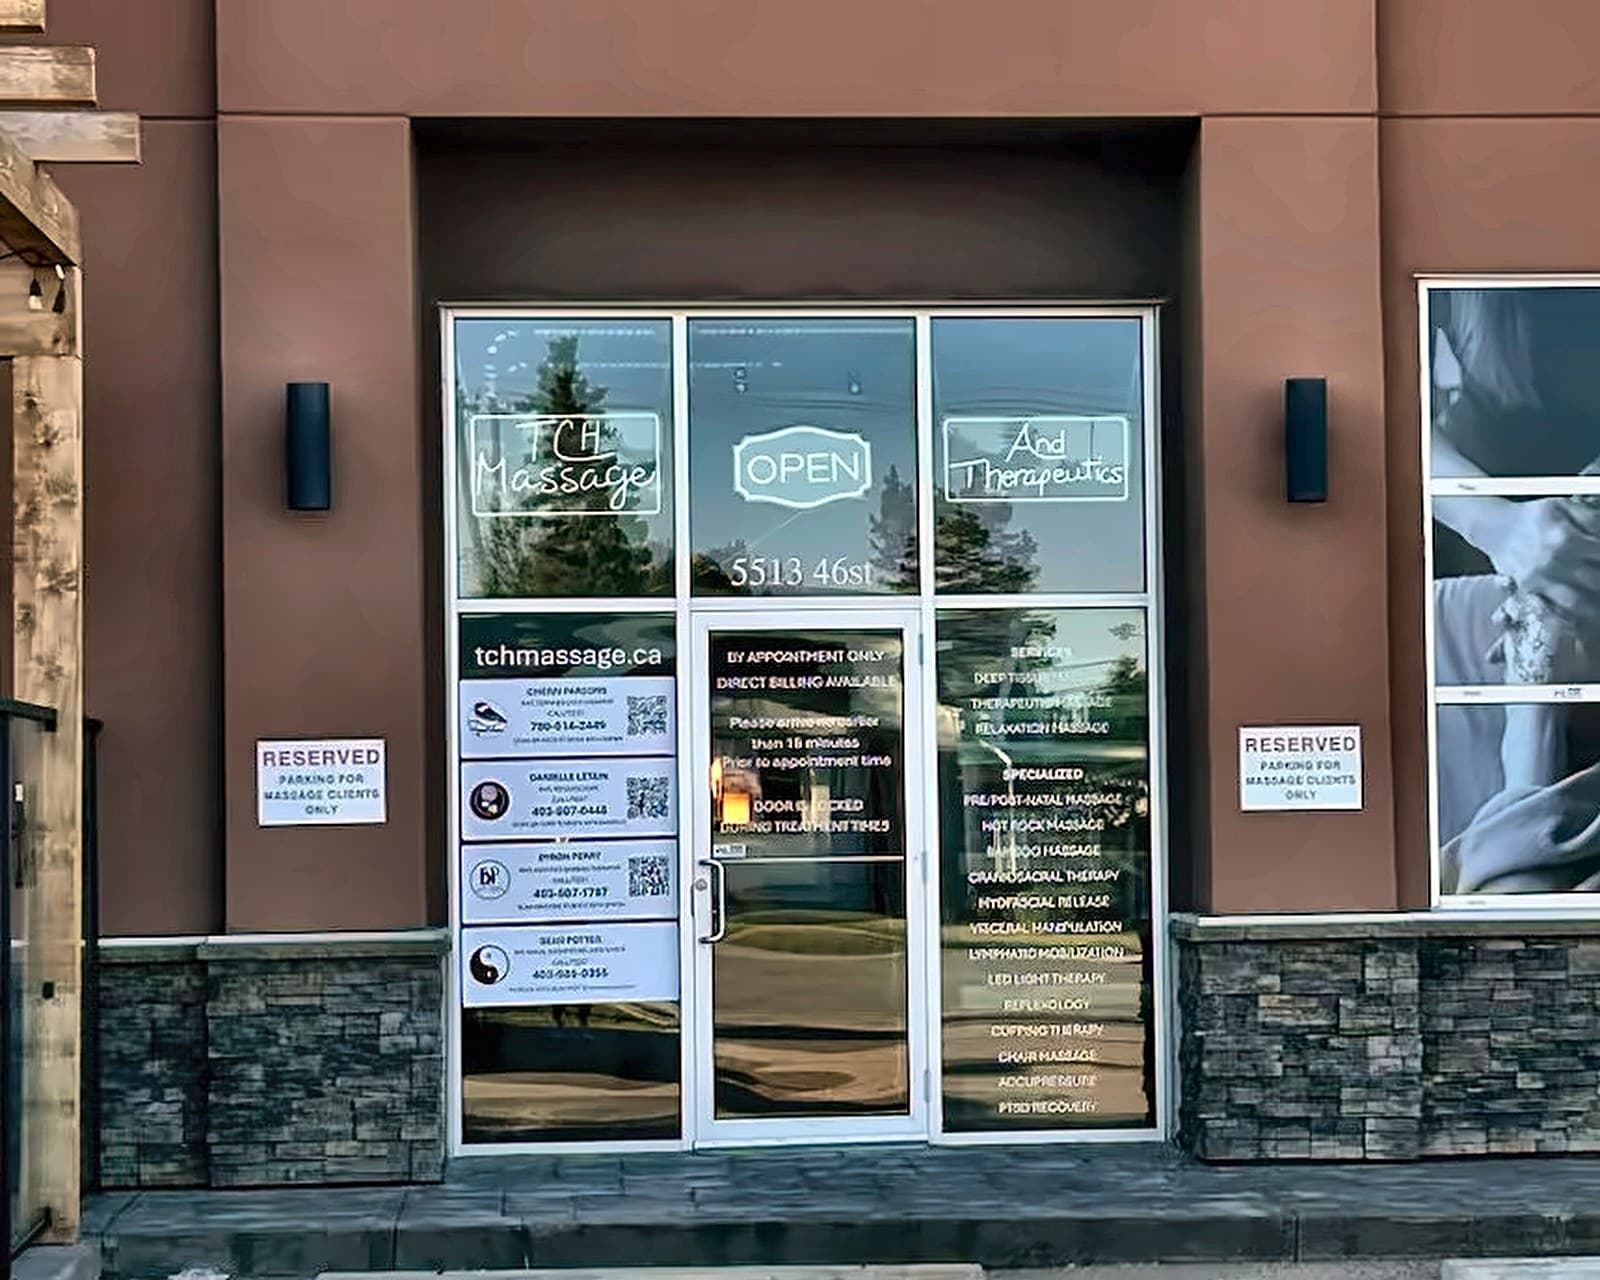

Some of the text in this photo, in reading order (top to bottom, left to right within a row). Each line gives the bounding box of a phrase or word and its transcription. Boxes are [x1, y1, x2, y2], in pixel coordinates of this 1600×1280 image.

[516, 419, 616, 461] TCH
[1005, 423, 1066, 462] And
[747, 452, 860, 484] OPEN
[477, 452, 656, 509] Massage
[950, 456, 1123, 496] Therapeutics
[731, 556, 873, 586] 5513 46st
[475, 645, 662, 669] tchmassage.ca
[727, 650, 885, 663] BY APPOINTMENT ONLY
[716, 675, 897, 689] DIRECT BILLING AVAILABLE
[974, 672, 1006, 684] DEEP
[975, 722, 1110, 735] RELAXATION MASSAGE
[751, 738, 783, 749] than
[805, 738, 861, 749] minutes
[1245, 736, 1356, 753] RESERVED
[263, 749, 380, 767] RESERVED
[756, 757, 770, 767] to
[772, 755, 859, 770] appointment
[861, 755, 892, 766] time
[1260, 760, 1341, 771] PARKING FOR
[279, 773, 364, 785] PARKING FOR
[1002, 768, 1083, 780] SPECIALIZED
[1245, 775, 1356, 786] MASSAGE CLIENTS
[264, 788, 380, 801] MASSAGE CLIENTS
[1066, 794, 1122, 806] MASSAGE
[1285, 789, 1317, 800] ONLY
[305, 804, 338, 815] ONLY
[753, 800, 795, 812] DOOR
[811, 799, 864, 812] OCKED
[982, 820, 1009, 831] HOT
[1047, 819, 1104, 831] MASSAGE
[1044, 845, 1101, 857] MASSAGE
[1065, 869, 1120, 882] THERAPY
[978, 895, 1111, 909] MYOFASCIAL RELEASE
[1014, 973, 1049, 985] LIGHT
[1050, 972, 1106, 984] THERAPY
[1050, 1024, 1104, 1036] THERAPY
[1039, 1050, 1099, 1062] MASSAGE
